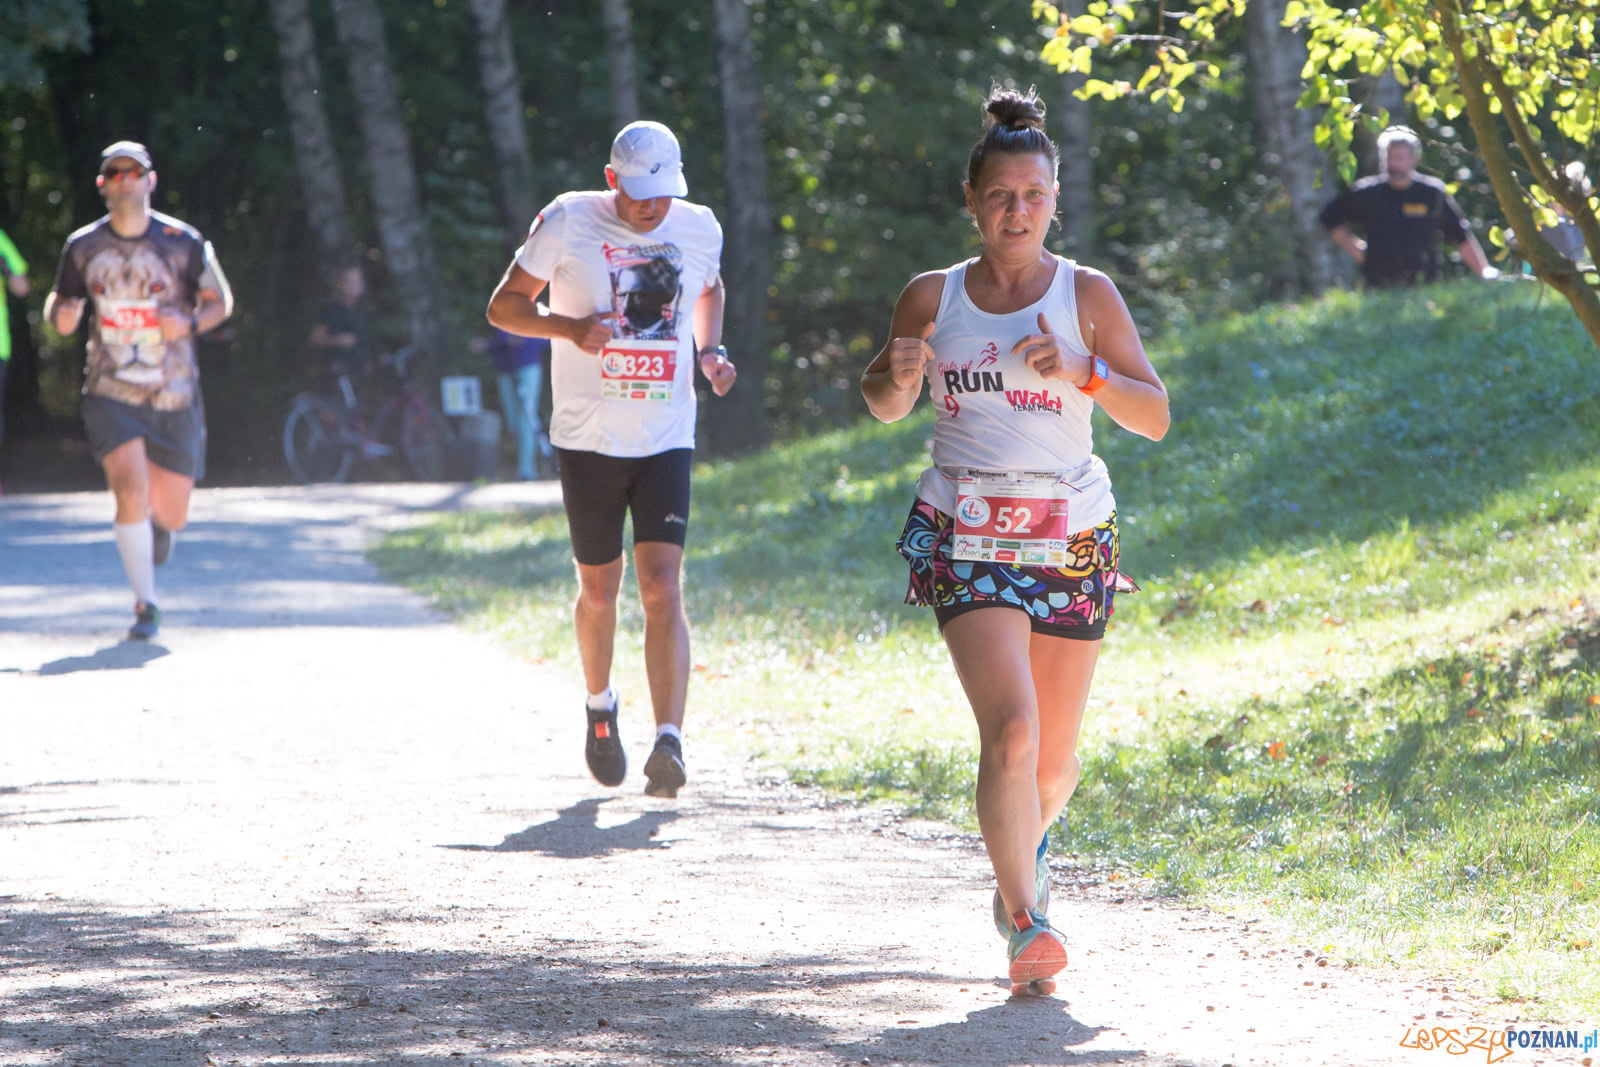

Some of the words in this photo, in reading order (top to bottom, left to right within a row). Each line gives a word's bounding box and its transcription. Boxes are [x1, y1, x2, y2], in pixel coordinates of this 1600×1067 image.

[624, 355, 665, 377] 323
[944, 369, 1004, 395] RUN
[1013, 403, 1036, 412] TEAM
[994, 506, 1032, 534] 52
